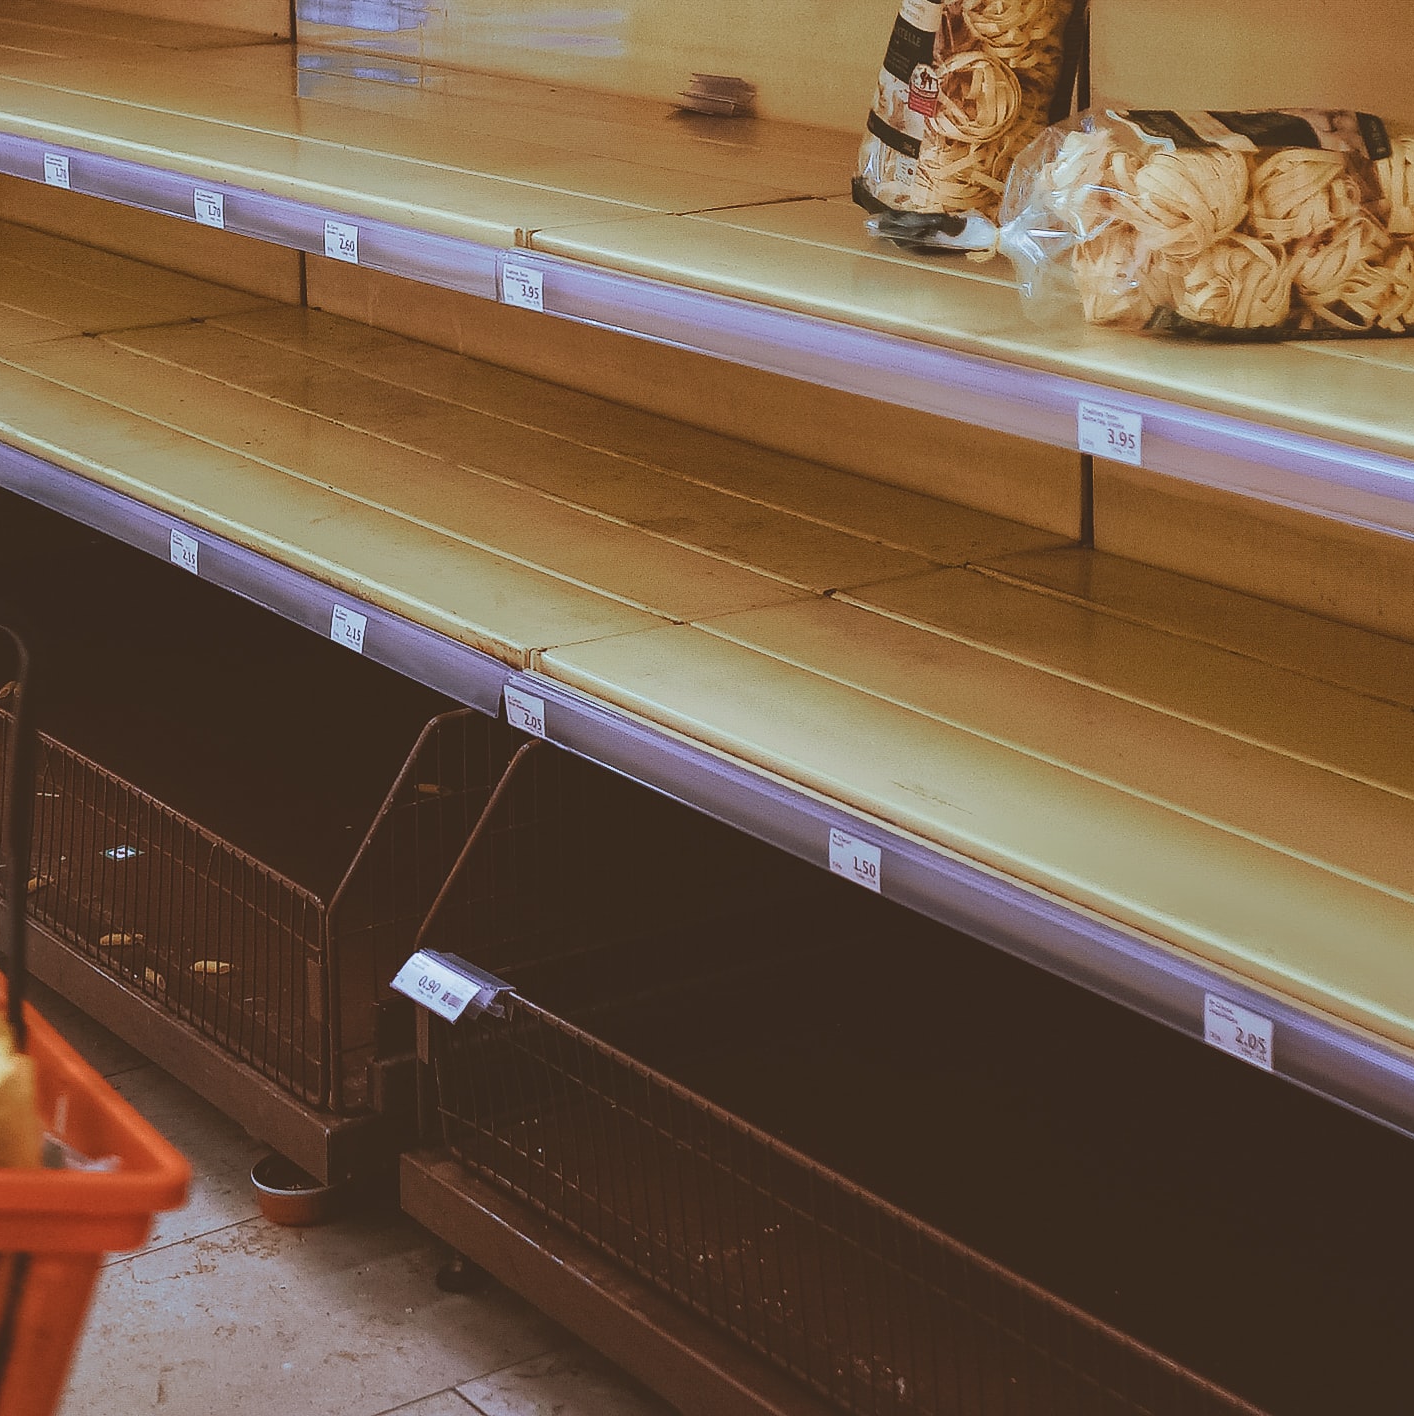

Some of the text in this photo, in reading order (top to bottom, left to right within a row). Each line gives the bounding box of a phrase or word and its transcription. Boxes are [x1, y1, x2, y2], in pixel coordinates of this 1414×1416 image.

[521, 284, 539, 299] 3.95
[1106, 428, 1136, 449] 3.95
[346, 624, 361, 641] 2.15
[418, 975, 441, 994] 0.90
[1235, 1026, 1267, 1055] 2.05
